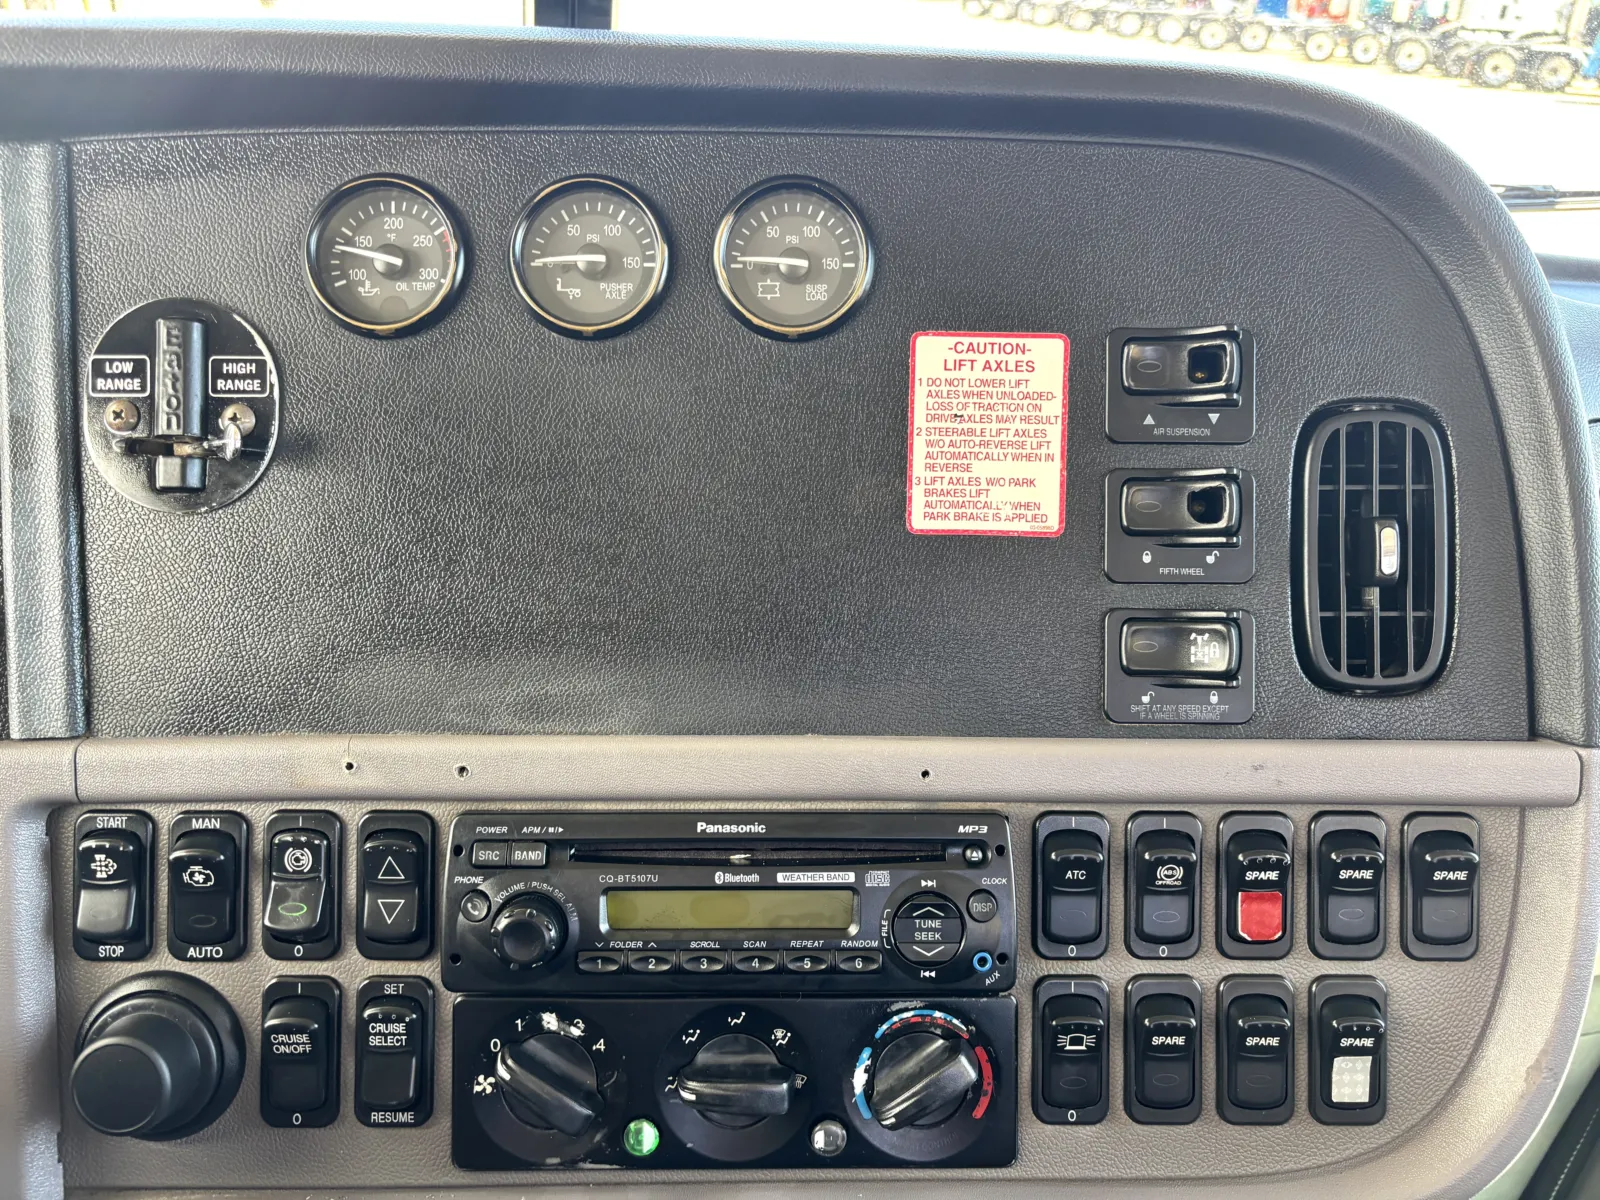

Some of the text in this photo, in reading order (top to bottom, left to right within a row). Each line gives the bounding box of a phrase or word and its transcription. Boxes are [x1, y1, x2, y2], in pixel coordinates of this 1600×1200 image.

[383, 217, 404, 230] 200
[567, 225, 581, 237] 50
[603, 225, 622, 237] 100
[766, 226, 780, 238] 50
[802, 226, 821, 238] 100
[354, 235, 373, 248] 150
[413, 235, 433, 248] 250
[586, 234, 600, 243] PSI
[785, 236, 799, 244] PSI
[622, 257, 641, 269] 150
[821, 258, 840, 270] 150
[348, 268, 367, 281] 100
[418, 268, 439, 280] 300
[395, 283, 436, 292] OIL TEMP
[600, 283, 633, 292] PUSHER
[805, 284, 828, 293] SUSP
[605, 292, 627, 300] AXLE
[805, 292, 828, 301] LOAD
[105, 361, 134, 374] LOW
[222, 362, 256, 374] HIGH
[943, 359, 1035, 372] LIFT AXLES
[97, 378, 142, 391] RANGE
[217, 379, 262, 391] RANGE
[918, 378, 1030, 388] 1 DO NOT LOWER LIFT
[926, 390, 960, 400] AXLES
[962, 390, 993, 400] WHEN
[926, 402, 1042, 412] LOSS OF TRACTION ON
[996, 415, 1018, 424] MAY
[1020, 416, 1060, 425] RESULT
[916, 427, 1047, 438] 2 STEERABLE LIFT AXLES
[1166, 428, 1211, 436] SUSPENSION
[925, 439, 1052, 450] W/O AUTO-REVERSE LIFT
[924, 451, 1055, 462] AUTOMATICALLY WHEN IN
[924, 463, 973, 472] REVERSE
[914, 476, 1036, 487] 3 LIFT AXLES W/O PARK
[924, 488, 990, 498] BRAKES LIFT
[923, 512, 1048, 523] PARK BRAKE IS APPLIED
[1160, 568, 1205, 576] FIFTH WHEEL
[1188, 713, 1220, 721] SPINNING
[96, 817, 128, 829] START
[192, 818, 221, 829] MAN
[696, 821, 767, 834] Panasonic
[958, 825, 988, 834] MP3
[478, 852, 500, 861] SRC
[514, 852, 542, 861] BAND
[454, 876, 484, 884] PHONE
[599, 875, 658, 883] CQ-BT5107U
[724, 873, 760, 882] Bluetooth
[782, 874, 850, 882] WEATHER BAND
[1066, 870, 1086, 880] ATC
[1245, 871, 1280, 880] SPARE
[1338, 870, 1374, 880] SPARE
[1433, 871, 1468, 880] SPARE
[494, 882, 526, 902] VOLUME
[532, 882, 554, 892] PUSH
[553, 890, 566, 902] SEL
[973, 902, 993, 912] DISP
[914, 920, 942, 928] TUNE
[914, 932, 942, 940] SEEK
[98, 945, 124, 957] STOP
[186, 946, 224, 958] AUTO
[596, 958, 602, 969] 1
[648, 958, 656, 969] 2
[700, 958, 708, 969] 3
[751, 958, 760, 969] 4
[803, 958, 811, 969] 5
[855, 958, 863, 969] 6
[985, 970, 1001, 986] AUX
[384, 984, 404, 994] SET
[369, 1022, 406, 1034] CRUISE
[515, 1018, 522, 1032] 1
[270, 1034, 310, 1043] CRUISE
[368, 1036, 408, 1046] SELECT
[1152, 1036, 1186, 1046] SPARE
[1246, 1037, 1280, 1046] SPARE
[1340, 1038, 1375, 1047] SPARE
[273, 1044, 312, 1054] ON/OFF
[490, 1038, 500, 1052] 0
[596, 1038, 606, 1052] 4
[371, 1112, 414, 1123] RESUME
